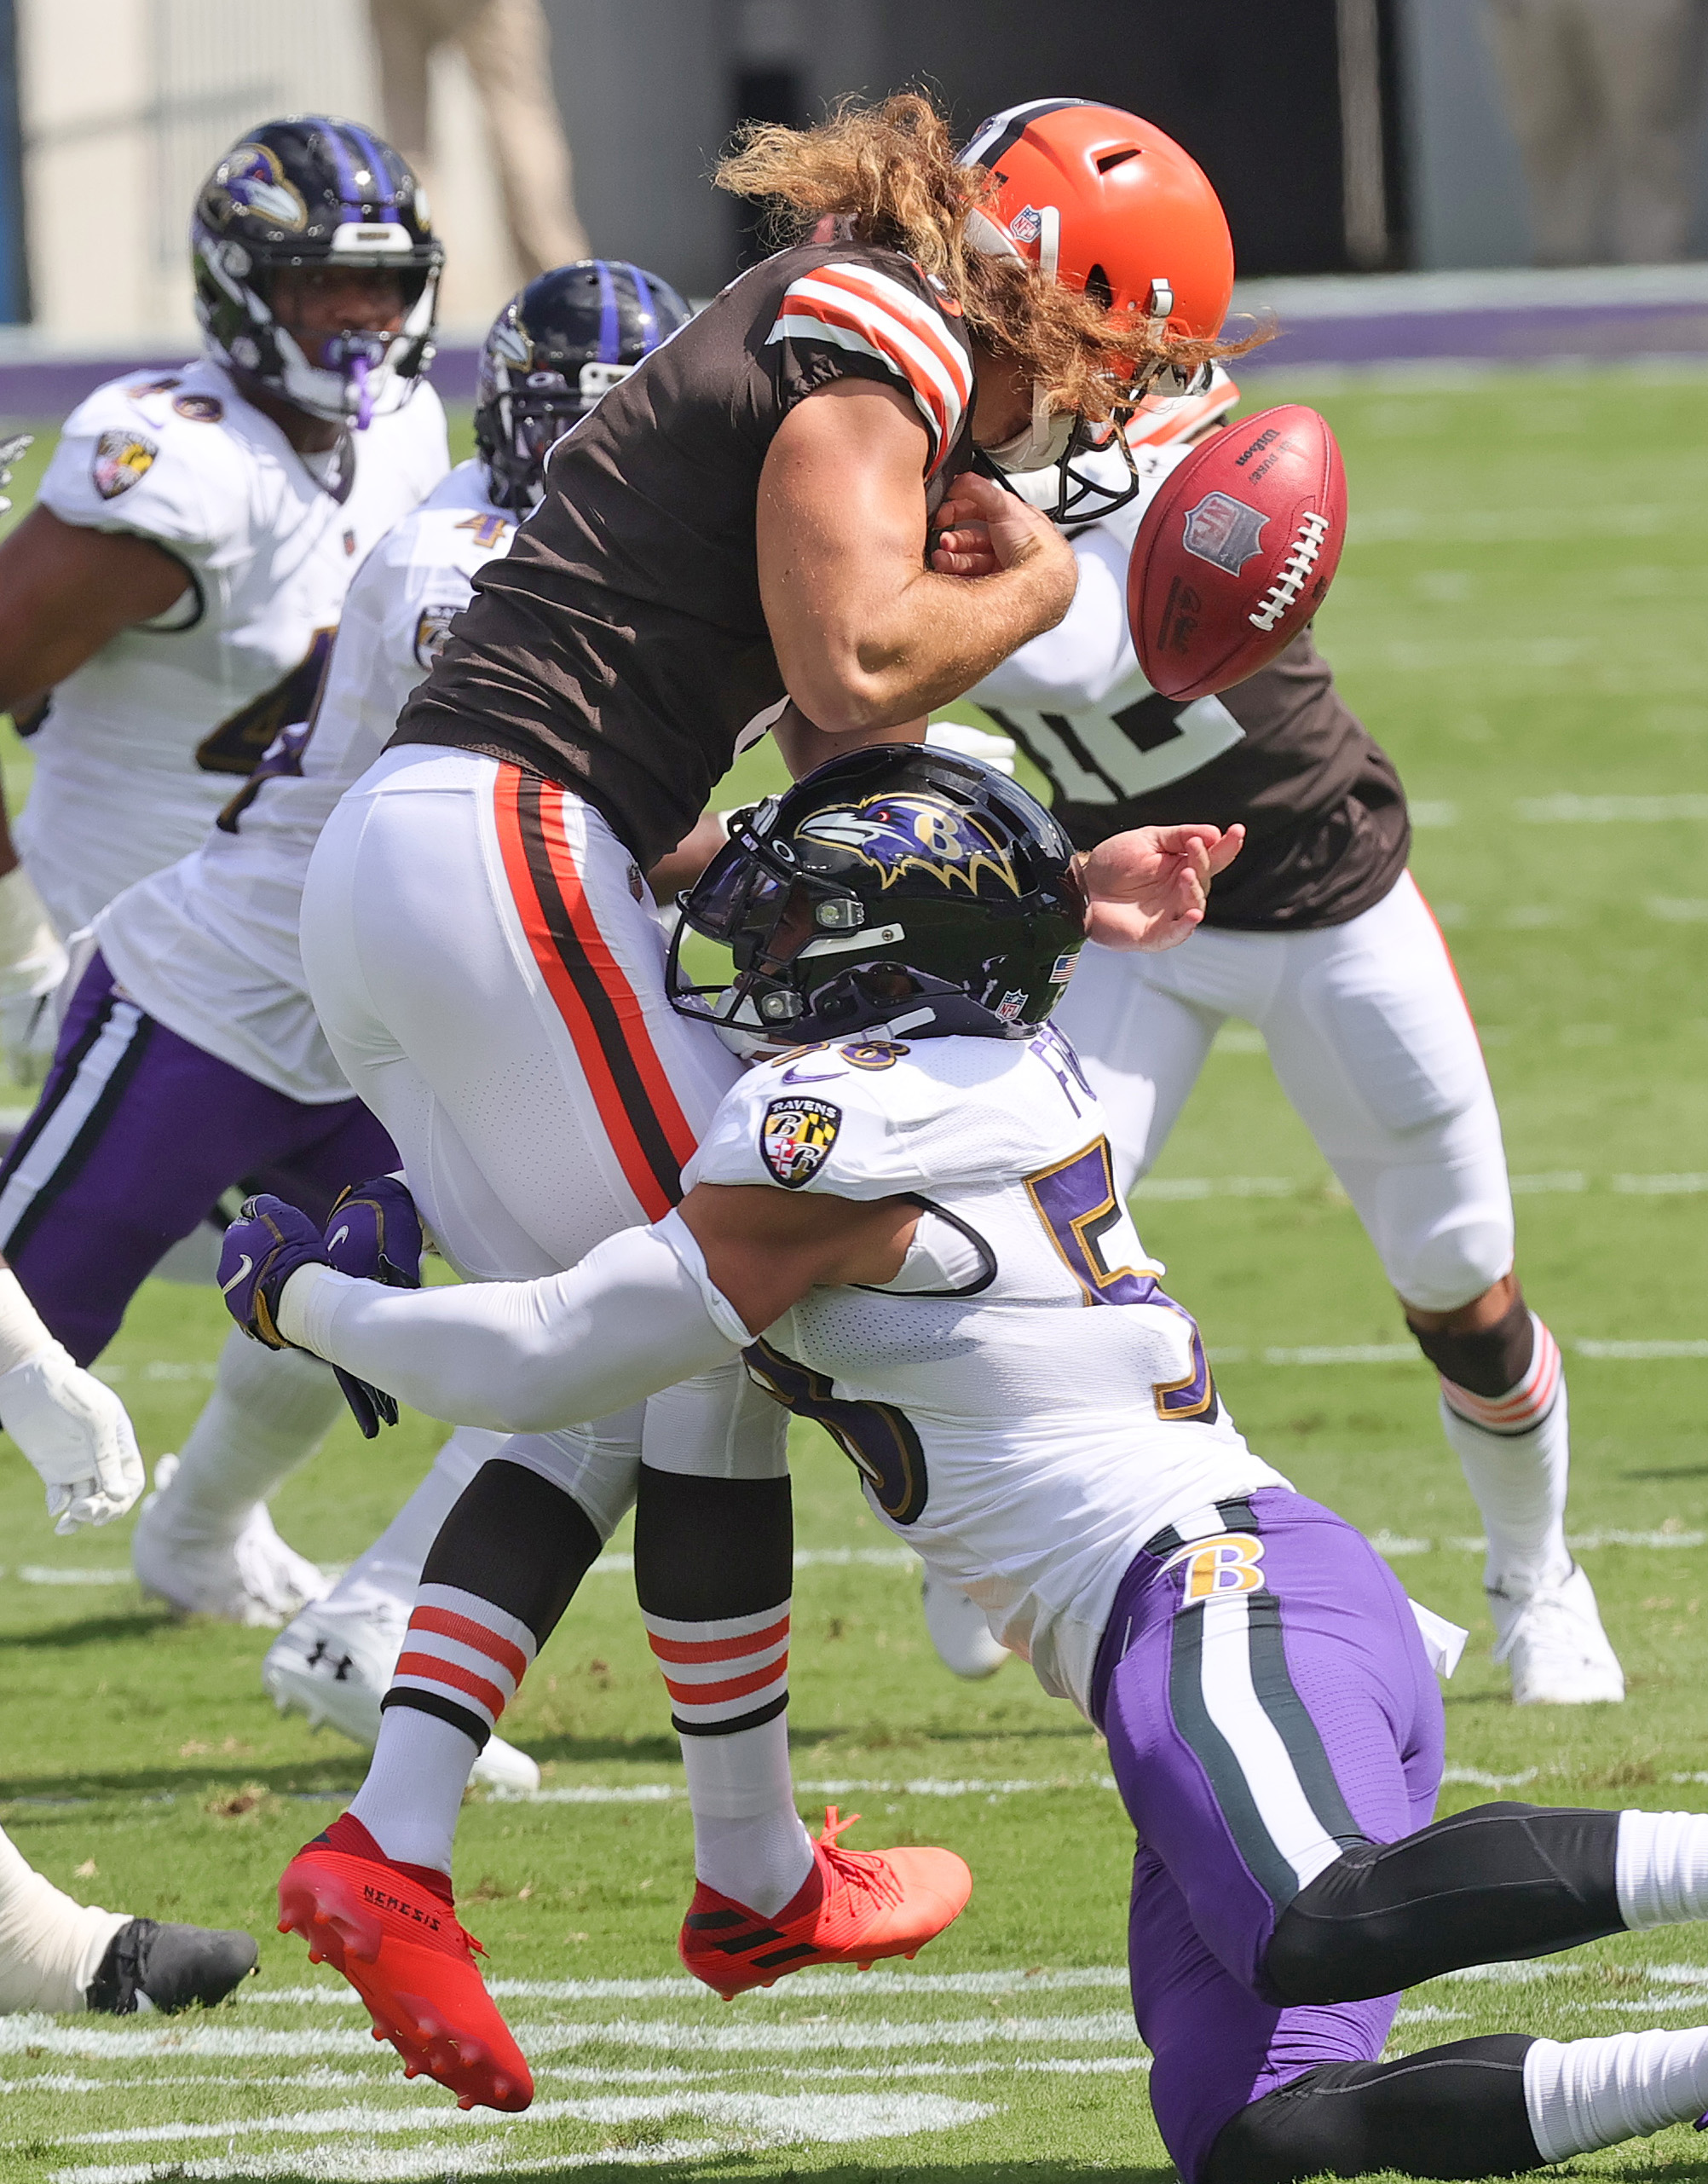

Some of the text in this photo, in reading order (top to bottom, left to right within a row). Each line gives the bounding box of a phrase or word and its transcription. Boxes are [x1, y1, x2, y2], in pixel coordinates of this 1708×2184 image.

[1235, 429, 1280, 466] Wilson
[914, 810, 963, 861] B
[770, 1100, 837, 1118] RAVENS
[770, 1111, 803, 1139] B
[790, 1142, 826, 1173] R
[1022, 1132, 1220, 1425] 5
[1151, 1532, 1266, 1606] B
[364, 1885, 441, 1932] NEMESIS
